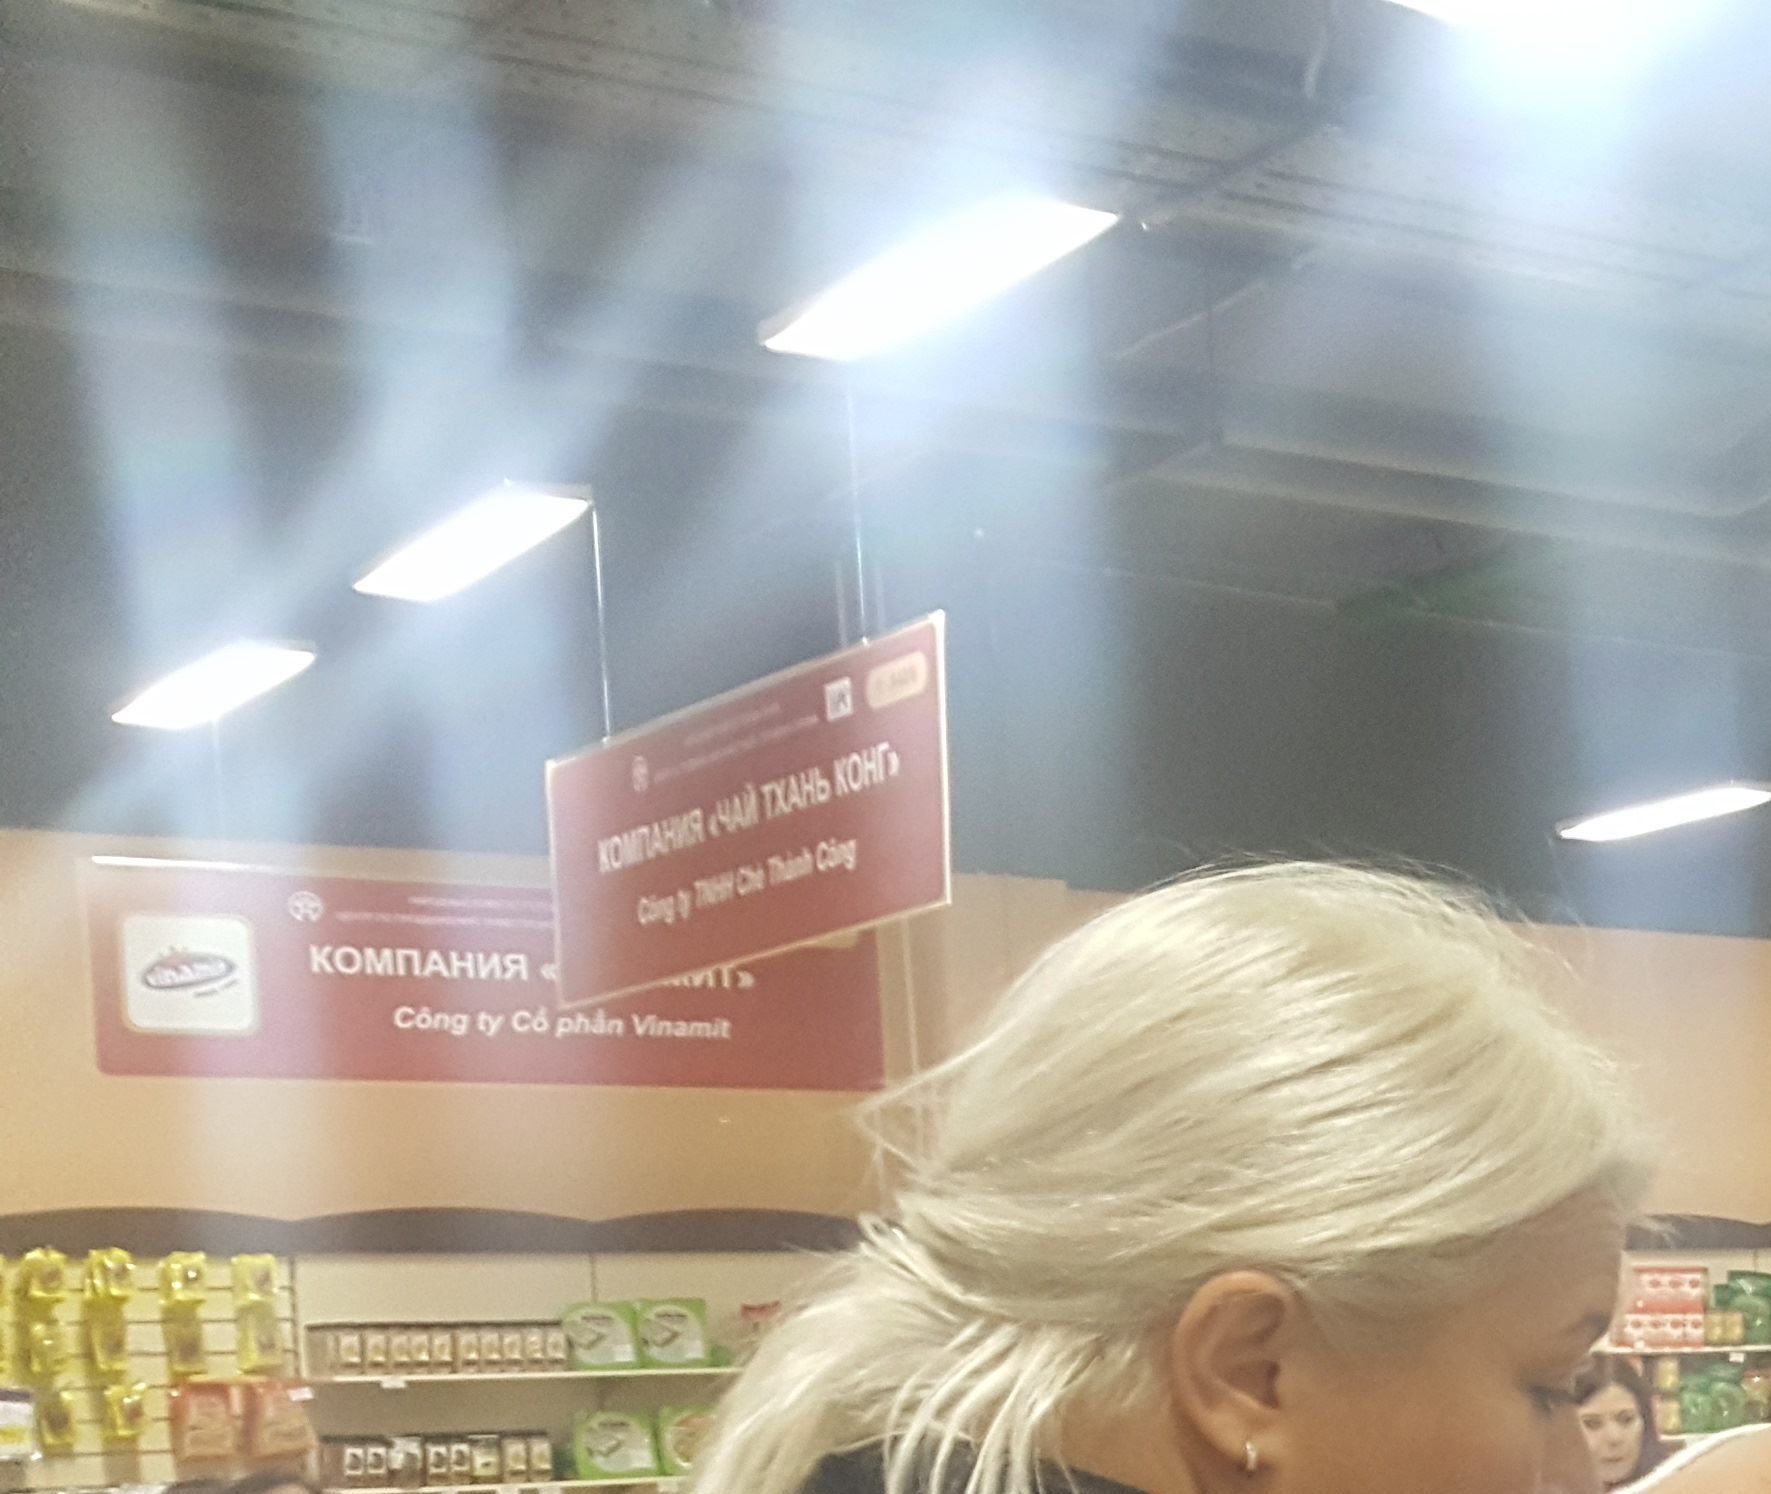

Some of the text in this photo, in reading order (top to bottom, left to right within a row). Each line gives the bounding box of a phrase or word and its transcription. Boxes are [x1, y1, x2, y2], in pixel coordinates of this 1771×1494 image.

[599, 809, 704, 873] КОМПАНИЯ
[761, 768, 830, 820] ТХАНЬ
[308, 944, 528, 982] КОМПАНИЯ
[393, 1006, 469, 1037] Công
[477, 1009, 504, 1037] ty
[632, 1013, 732, 1040] Vinamit
